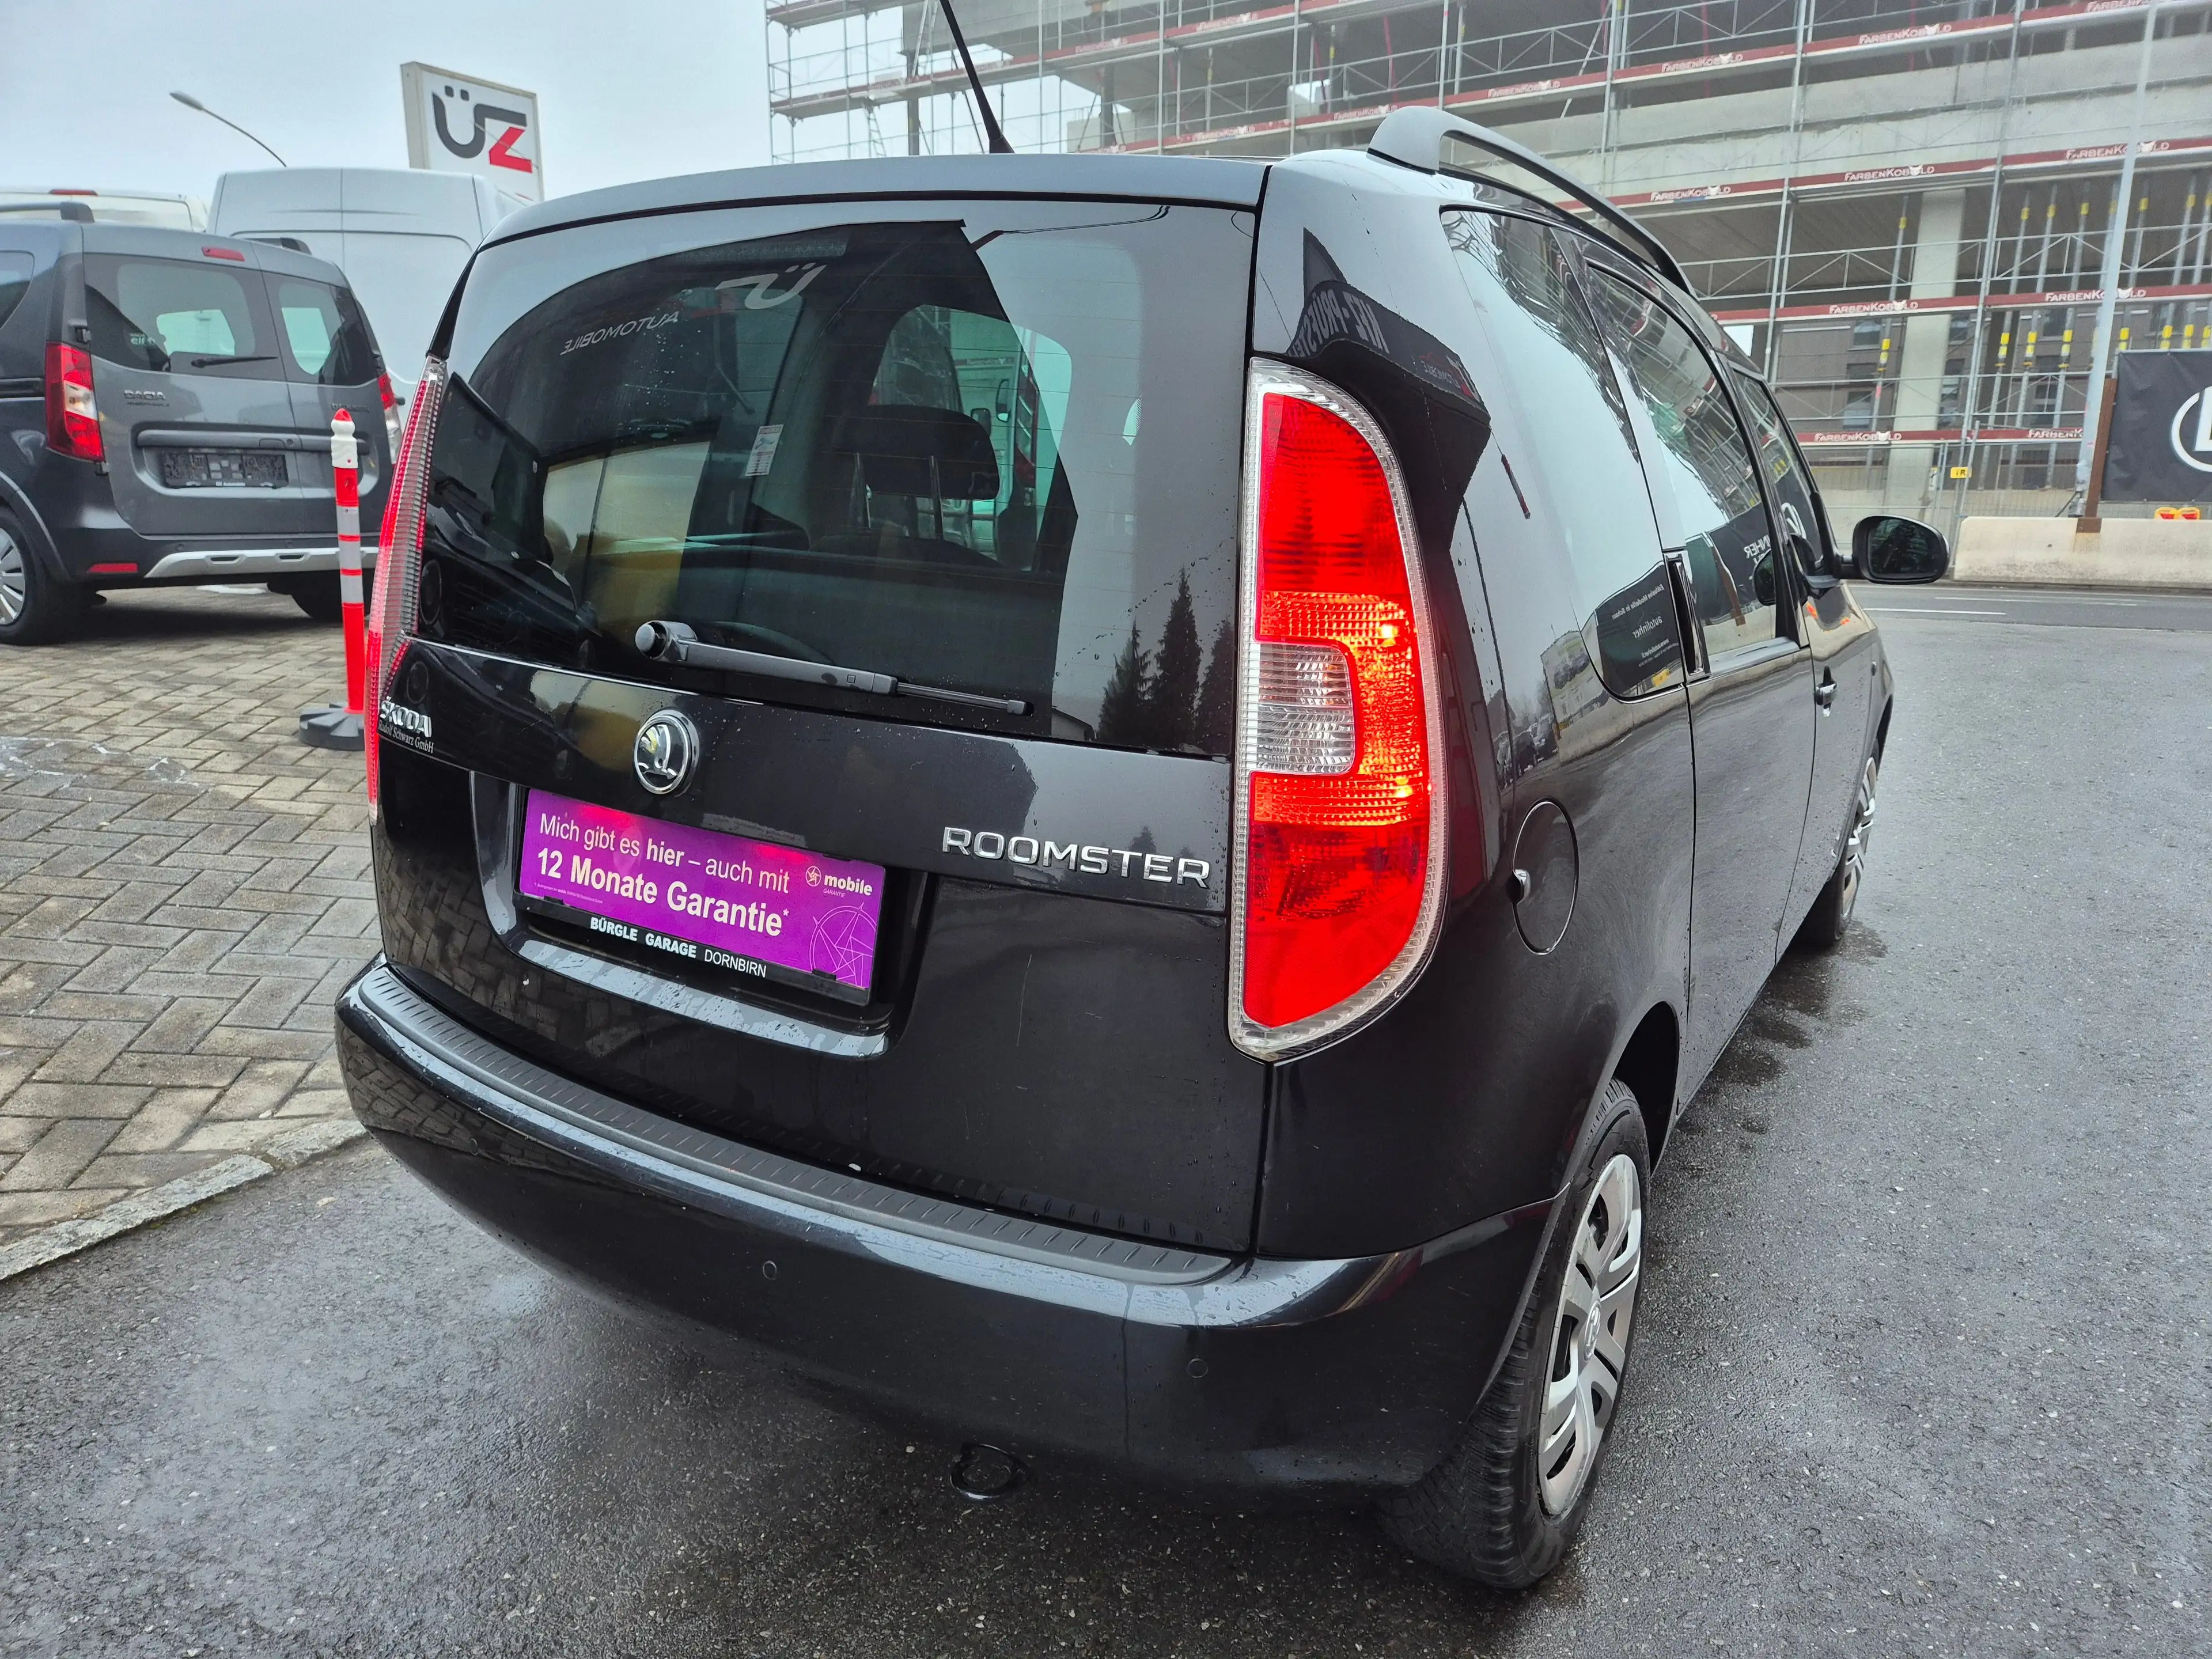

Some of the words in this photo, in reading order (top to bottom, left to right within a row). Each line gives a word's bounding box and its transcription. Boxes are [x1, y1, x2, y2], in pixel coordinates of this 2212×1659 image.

[392, 727, 415, 746] Schwarz
[415, 736, 434, 754] GmbH
[537, 847, 561, 879] 12
[571, 854, 658, 904] Monate
[540, 813, 579, 842] Mich
[584, 824, 615, 853] gibt
[619, 837, 640, 857] es
[647, 838, 685, 868] hier
[706, 854, 752, 884] auch
[759, 869, 790, 894] mit
[942, 826, 1210, 889] ROOMSTER
[823, 888, 846, 898] GARANTIE
[824, 874, 873, 896] mobile
[590, 916, 638, 942] BÜRGLE
[645, 933, 698, 959] GARAGE
[704, 948, 767, 979] DORNBIRN
